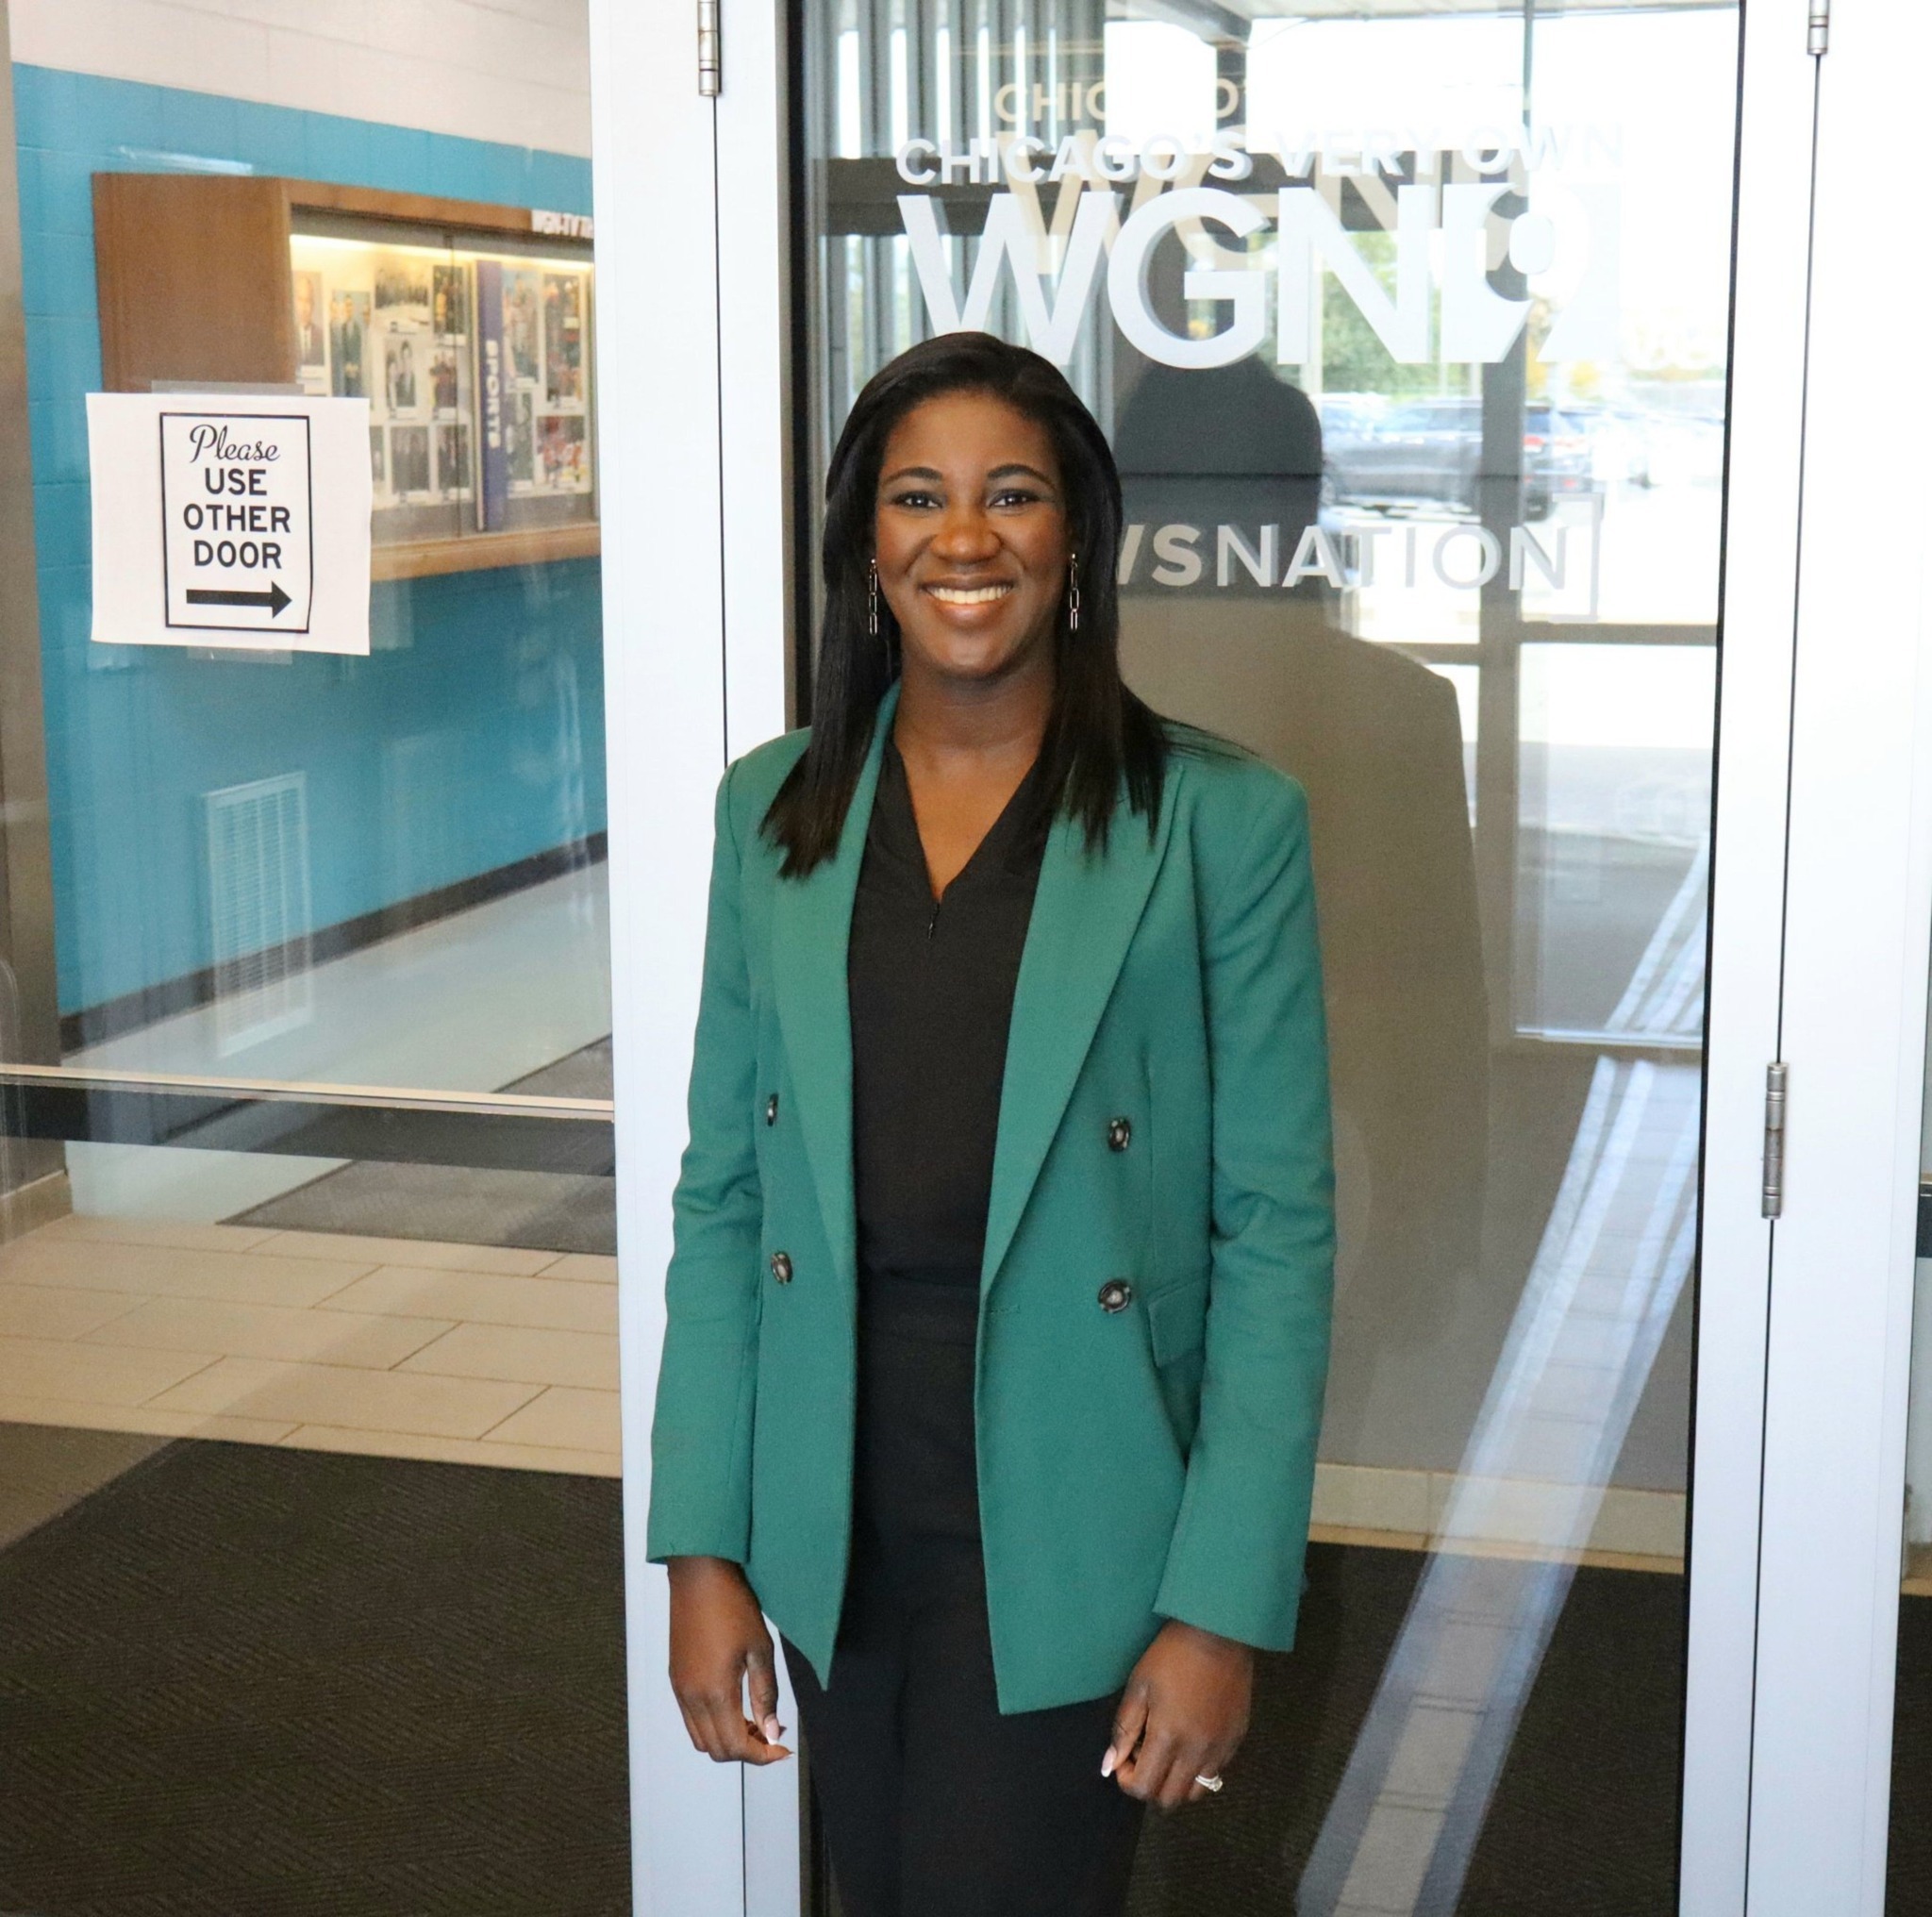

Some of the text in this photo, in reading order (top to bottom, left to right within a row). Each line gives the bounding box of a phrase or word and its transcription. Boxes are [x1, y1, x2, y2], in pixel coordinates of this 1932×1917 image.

[896, 121, 1624, 185] CHICAGO'S VERY OWN
[189, 424, 280, 463] Please
[204, 467, 267, 495] USE
[183, 503, 291, 533] OTHER
[193, 540, 282, 569] DOOR
